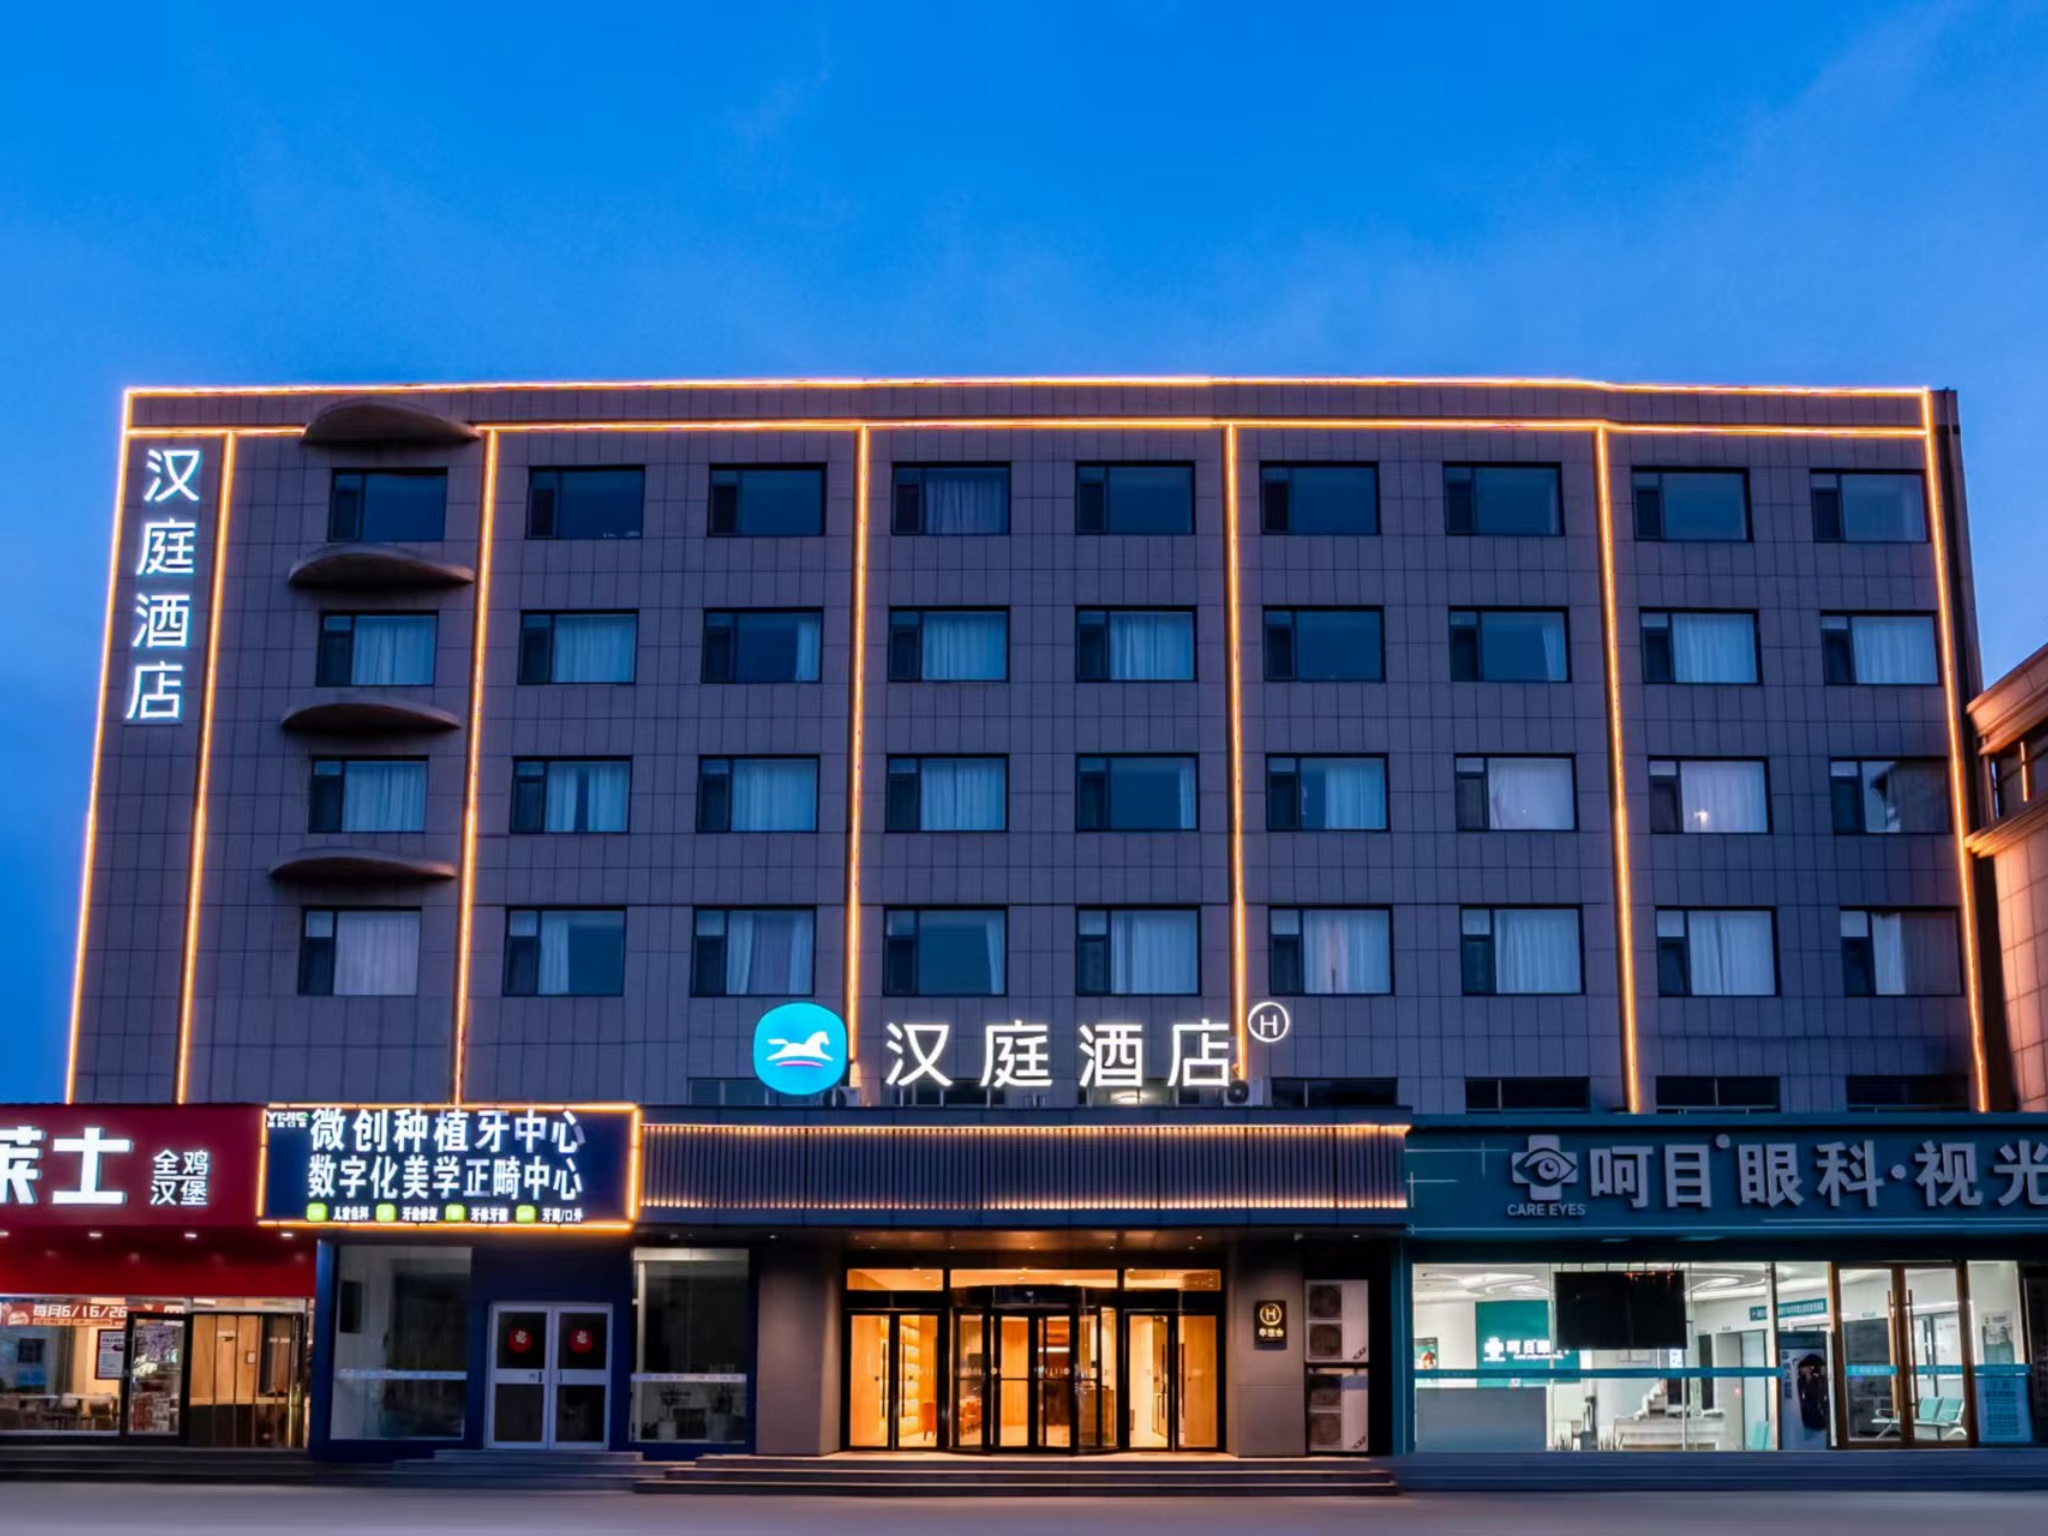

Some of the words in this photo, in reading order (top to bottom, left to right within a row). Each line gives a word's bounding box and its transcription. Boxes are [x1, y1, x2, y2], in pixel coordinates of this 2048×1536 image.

[126, 448, 201, 719] 汉庭酒店
[886, 1020, 1230, 1088] 汉庭酒店
[310, 1108, 586, 1154] 微创种植牙中心
[152, 1149, 209, 1175] 全鸡
[308, 1153, 583, 1201] 数字化美学正畸中心
[150, 1179, 208, 1206] 汉堡
[1507, 1204, 1545, 1216] CARE
[1550, 1203, 1586, 1216] EYES
